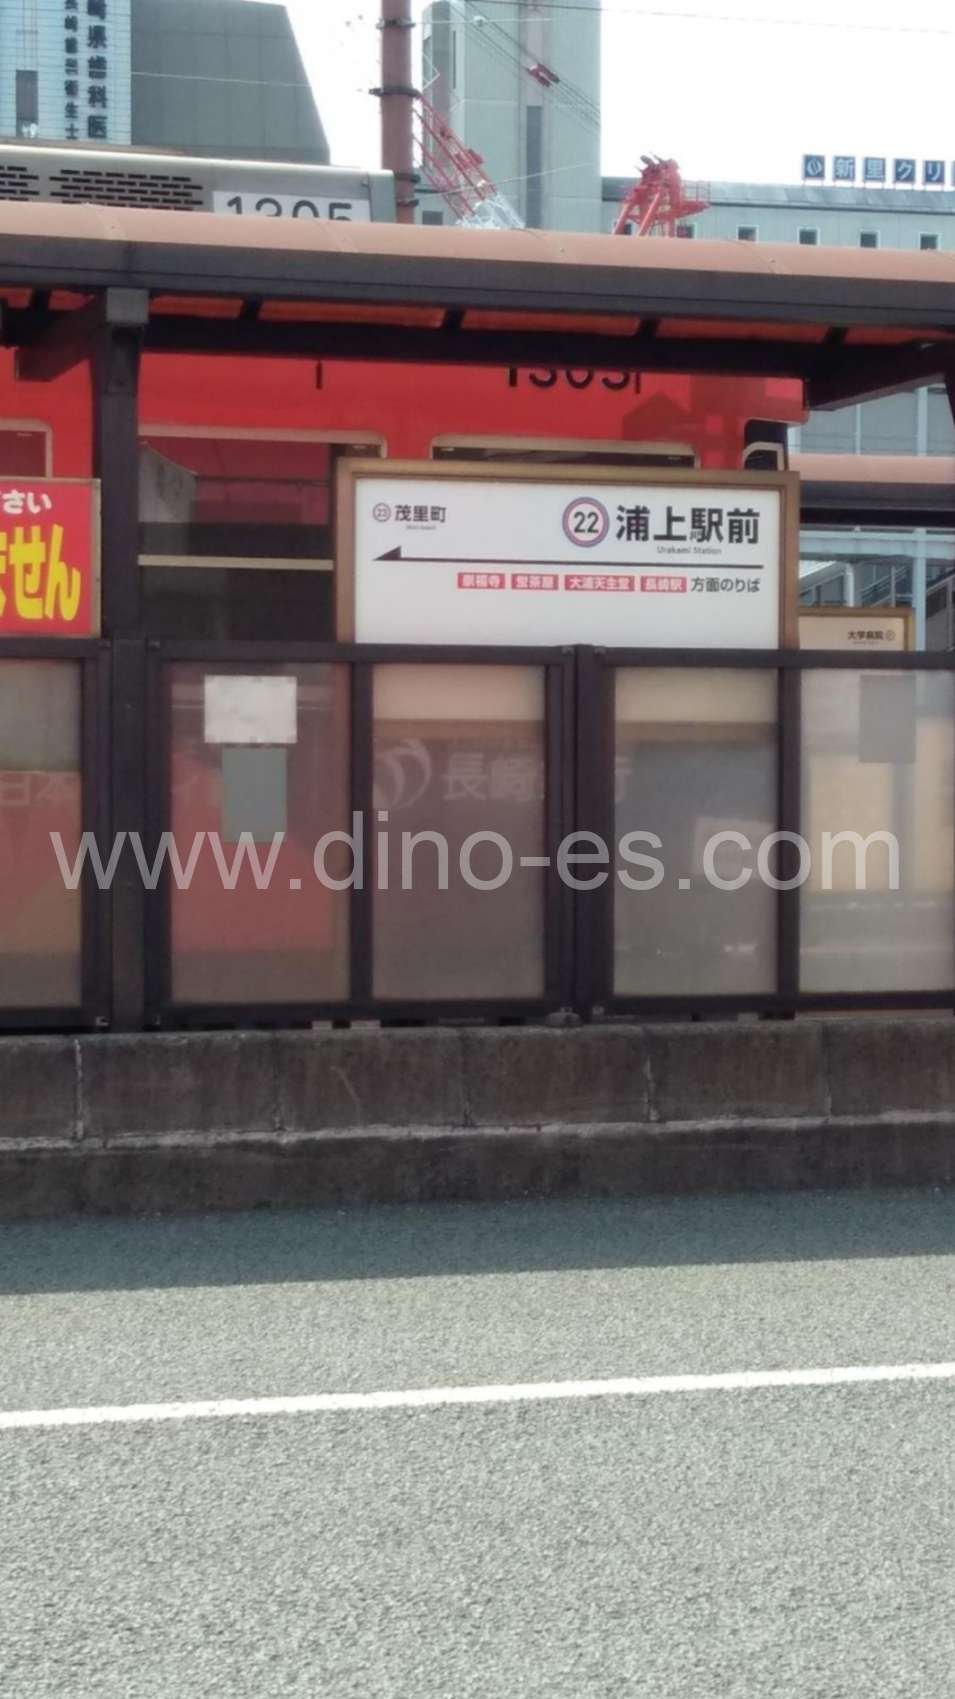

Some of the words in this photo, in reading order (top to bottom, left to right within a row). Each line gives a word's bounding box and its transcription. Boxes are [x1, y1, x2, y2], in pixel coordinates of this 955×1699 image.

[0, 489, 52, 514] さい
[394, 504, 446, 523] 茂里町
[573, 511, 599, 534] 22
[615, 505, 760, 544] 浦上駅前
[0, 523, 81, 622] せん
[691, 577, 761, 593] 方面のりば
